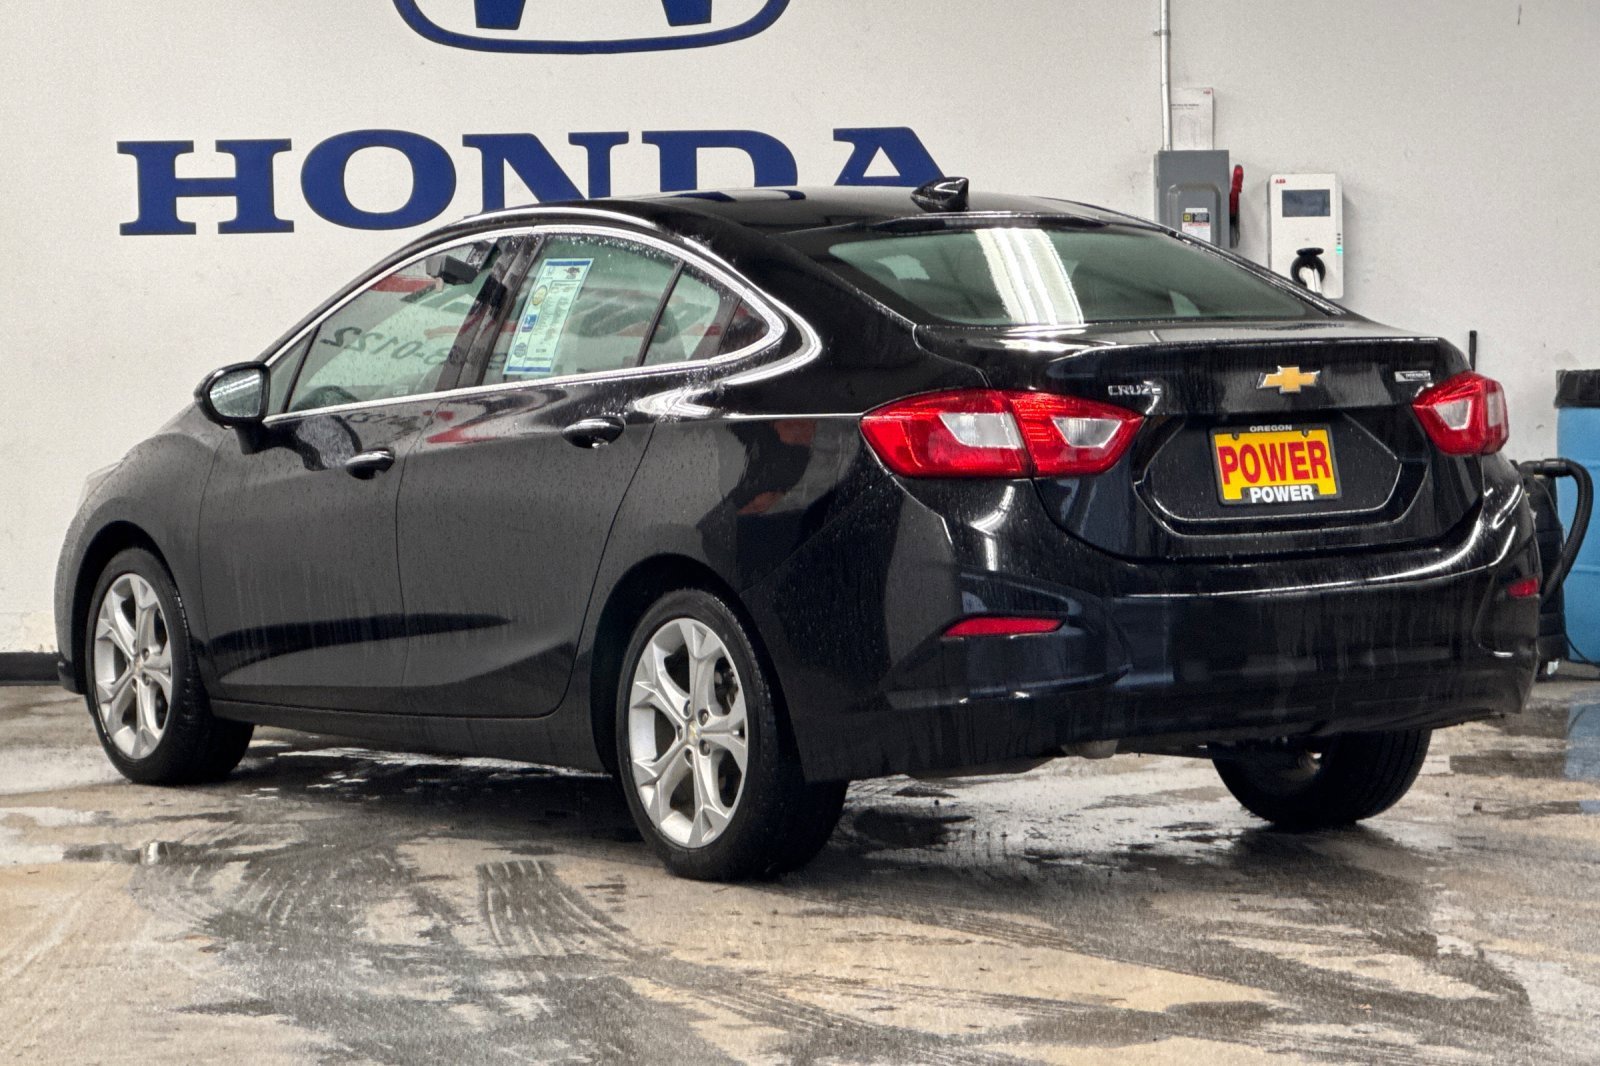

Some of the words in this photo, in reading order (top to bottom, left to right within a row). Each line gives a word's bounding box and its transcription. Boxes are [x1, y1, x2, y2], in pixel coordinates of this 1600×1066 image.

[116, 126, 947, 235] HONDA
[1249, 424, 1293, 433] OREGON
[1218, 440, 1331, 485] POWER
[1249, 485, 1314, 503] POWER
